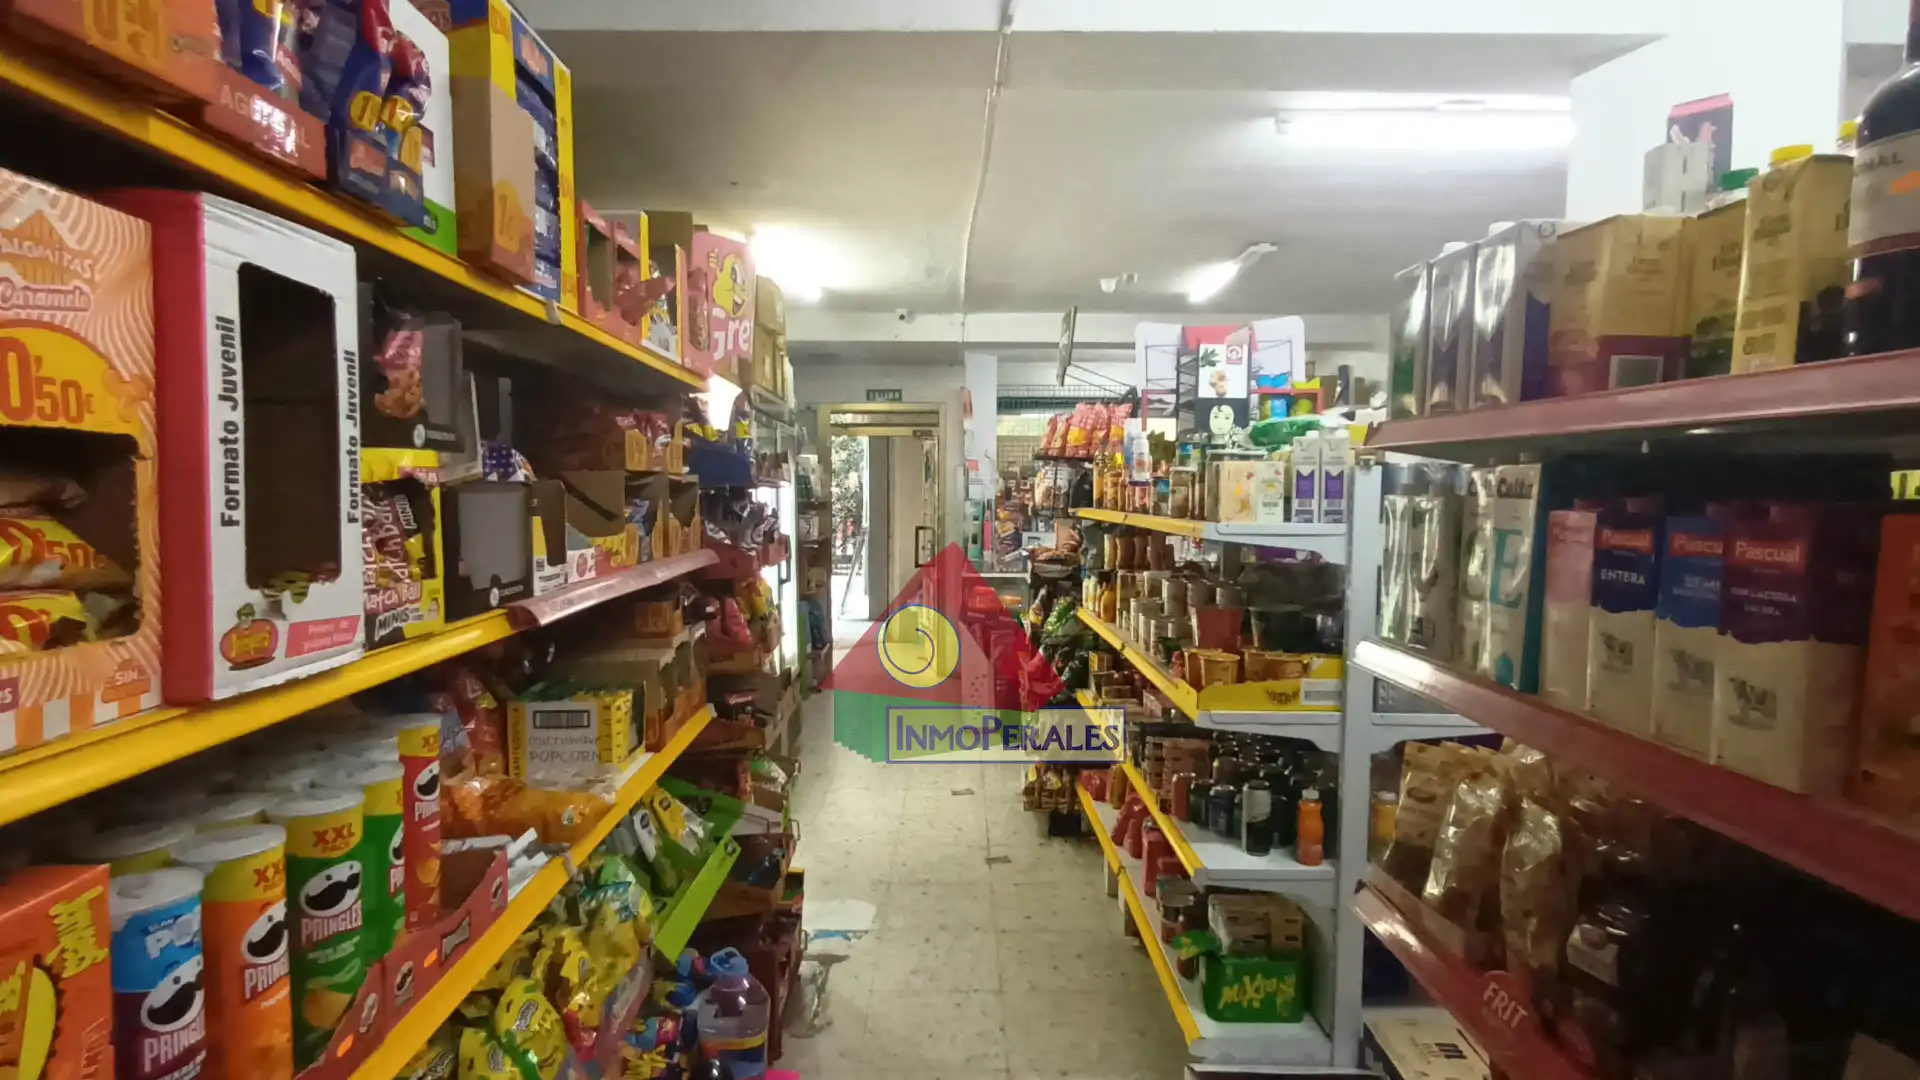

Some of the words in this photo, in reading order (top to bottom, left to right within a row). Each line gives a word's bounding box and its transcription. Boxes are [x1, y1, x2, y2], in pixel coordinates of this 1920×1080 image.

[215, 316, 239, 412] Juvenil
[342, 350, 358, 428] Juvenil
[219, 419, 241, 528] Formato
[344, 435, 360, 524] Formato
[1735, 540, 1801, 563] Pascual
[1601, 567, 1646, 586] ENTERA
[115, 669, 139, 685] SIN
[312, 823, 355, 848] XXL
[301, 900, 362, 944] PRINGLES
[1484, 980, 1528, 1029] FRIT
